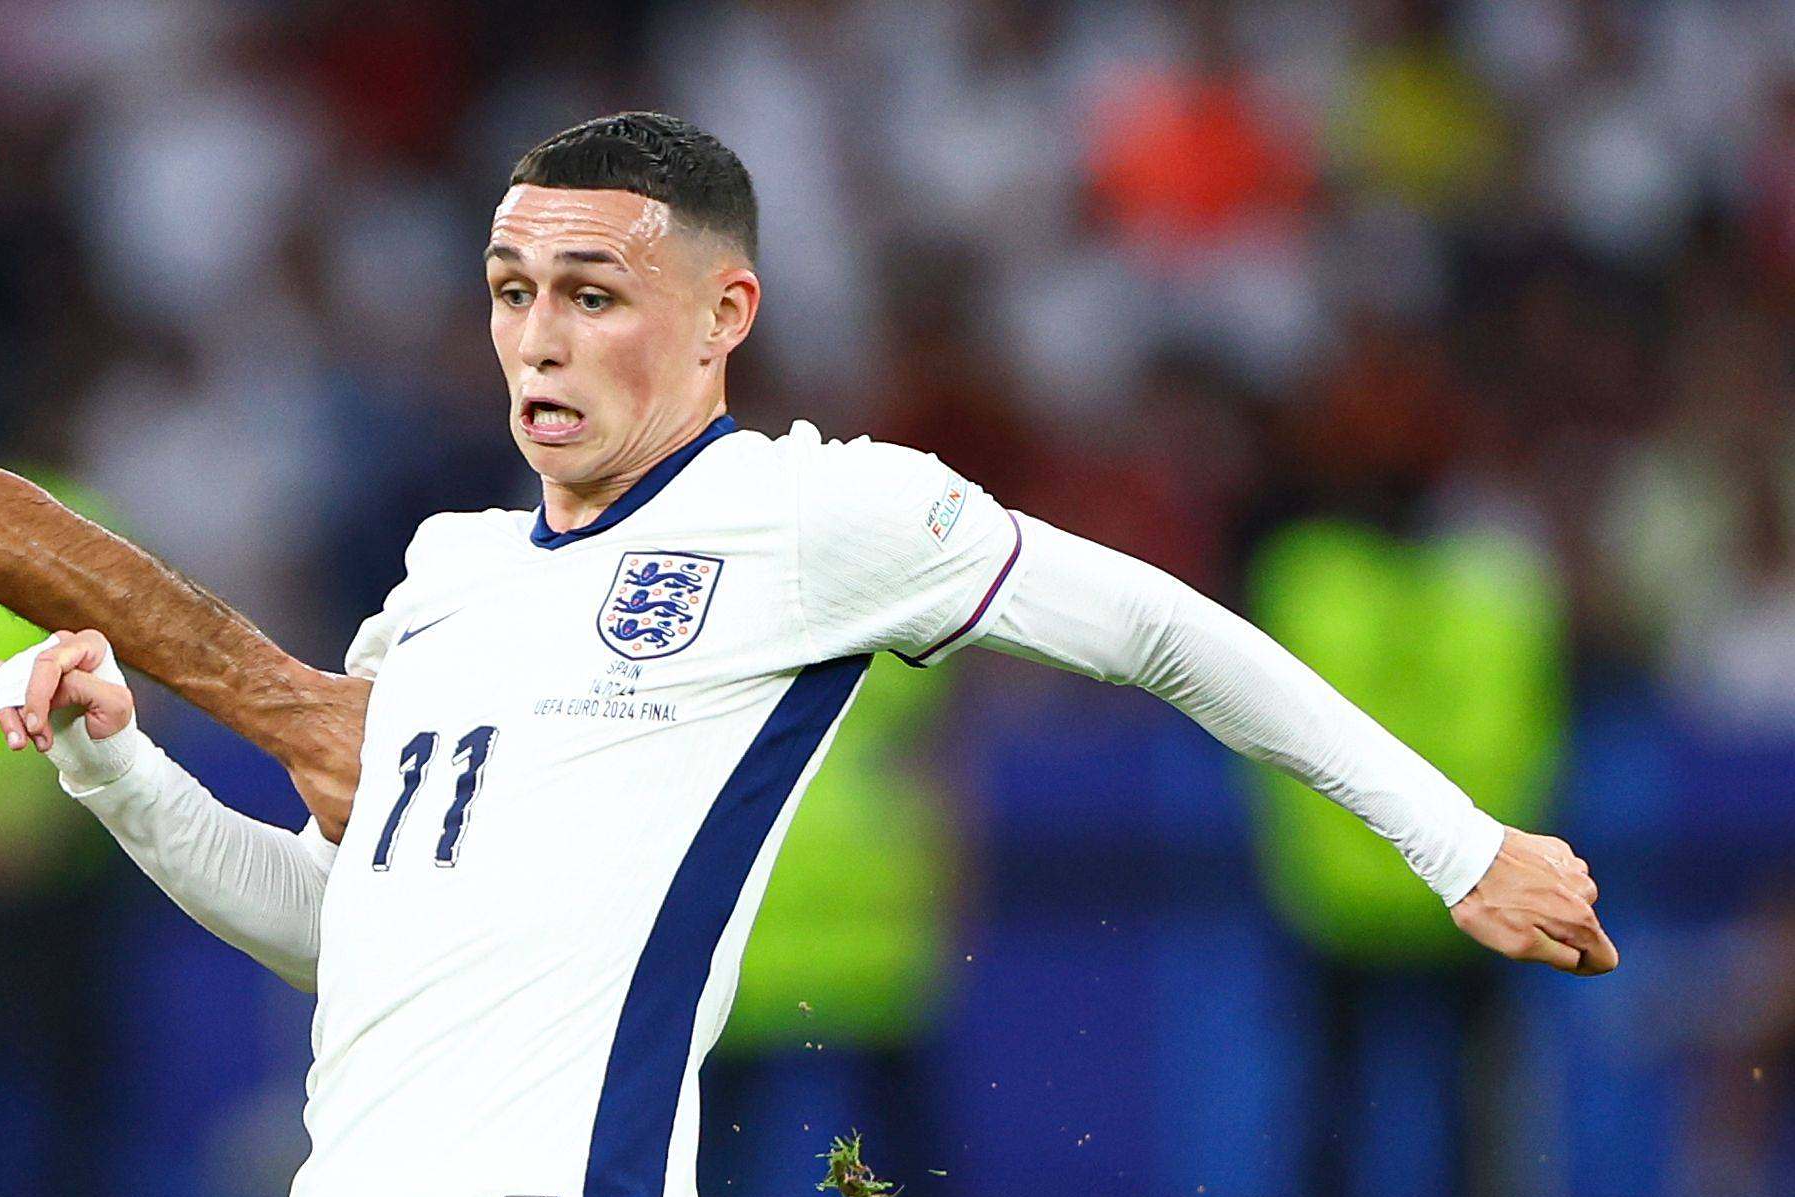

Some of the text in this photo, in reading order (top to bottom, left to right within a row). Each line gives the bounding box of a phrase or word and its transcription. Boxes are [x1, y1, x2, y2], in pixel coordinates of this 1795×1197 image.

[606, 660, 643, 680] SPAIN
[534, 699, 677, 722] UEFA EURO 2024 FINAL
[372, 726, 500, 872] 11
